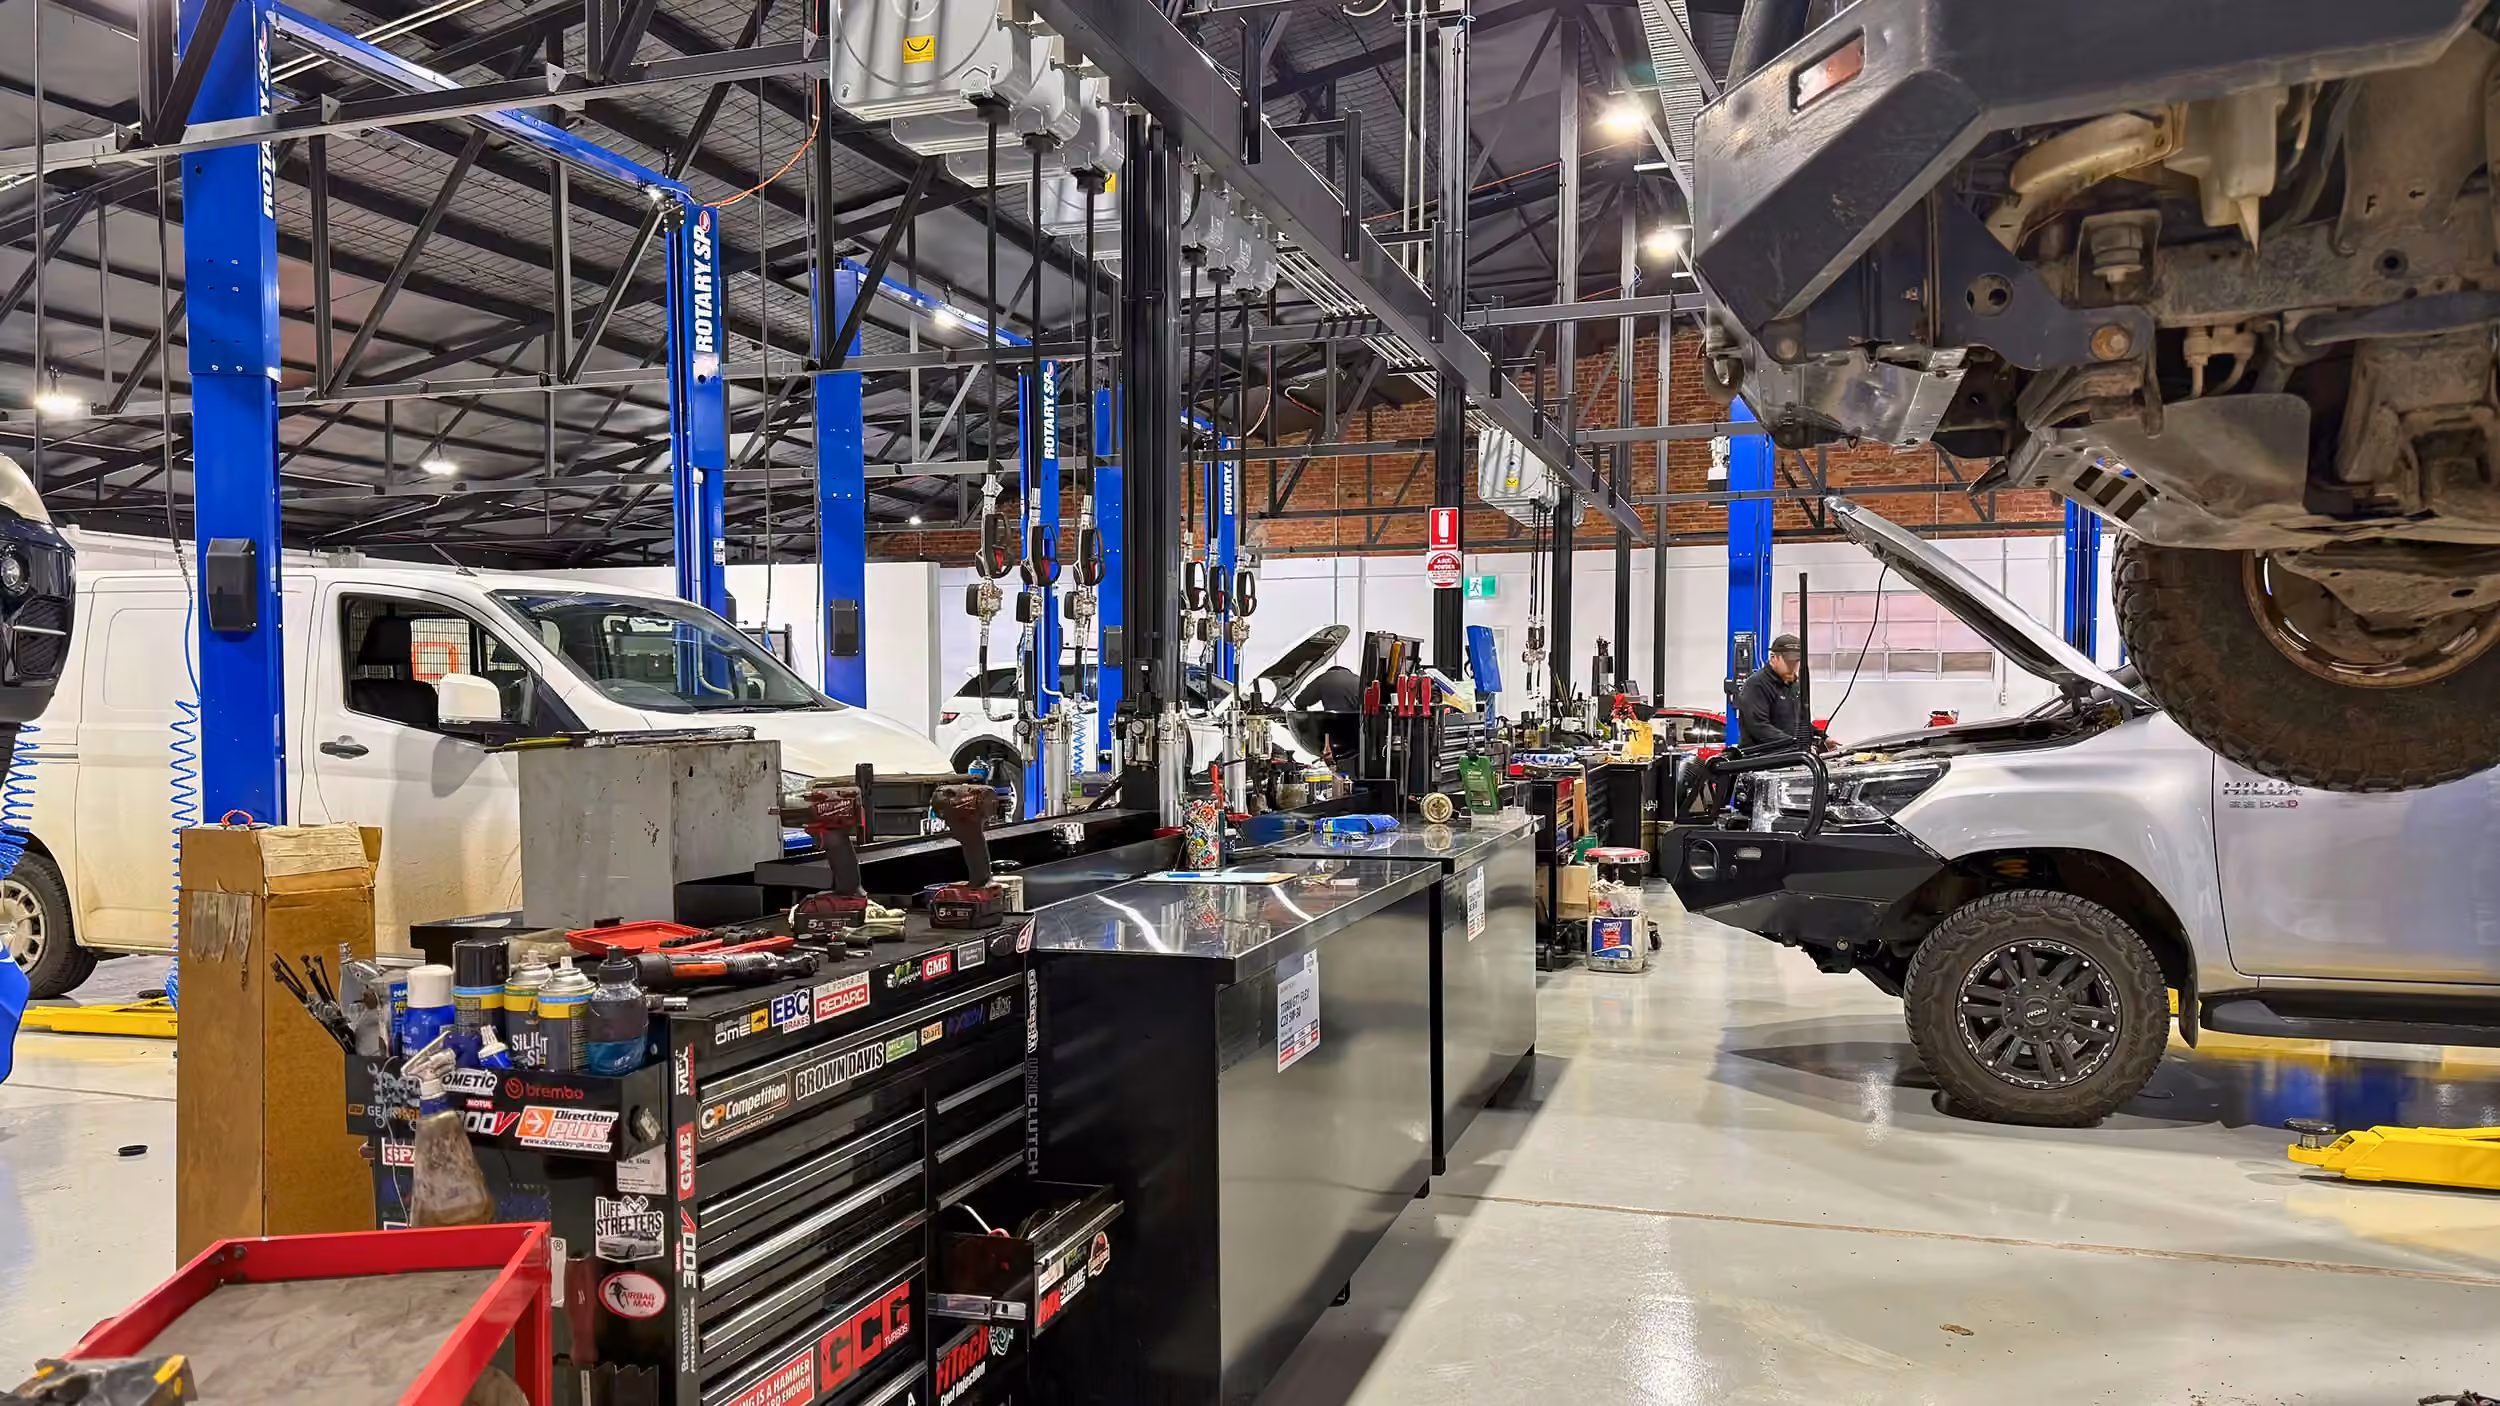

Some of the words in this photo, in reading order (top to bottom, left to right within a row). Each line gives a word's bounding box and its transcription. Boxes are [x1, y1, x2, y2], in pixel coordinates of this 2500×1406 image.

[260, 87, 274, 219] ROTAY
[925, 956, 948, 977] GME
[772, 990, 810, 1026] EBC
[818, 989, 865, 1015] REDARC
[783, 1015, 810, 1032] BRAKES
[443, 1072, 497, 1090] OMETIC
[796, 1054, 847, 1100] BROWN
[847, 1043, 885, 1080] DAVIS
[526, 1083, 585, 1099] brembo
[725, 1082, 786, 1121] Competition
[458, 1110, 520, 1136] 00V
[555, 1109, 613, 1124] Direction
[550, 1120, 611, 1142] PLUS
[680, 1132, 692, 1191] GME
[597, 1198, 622, 1218] TUFF
[596, 1212, 662, 1237] STREETERS
[680, 1206, 697, 1288] 300V
[883, 1322, 909, 1349] TURBOS
[773, 1358, 811, 1393] HAMMER
